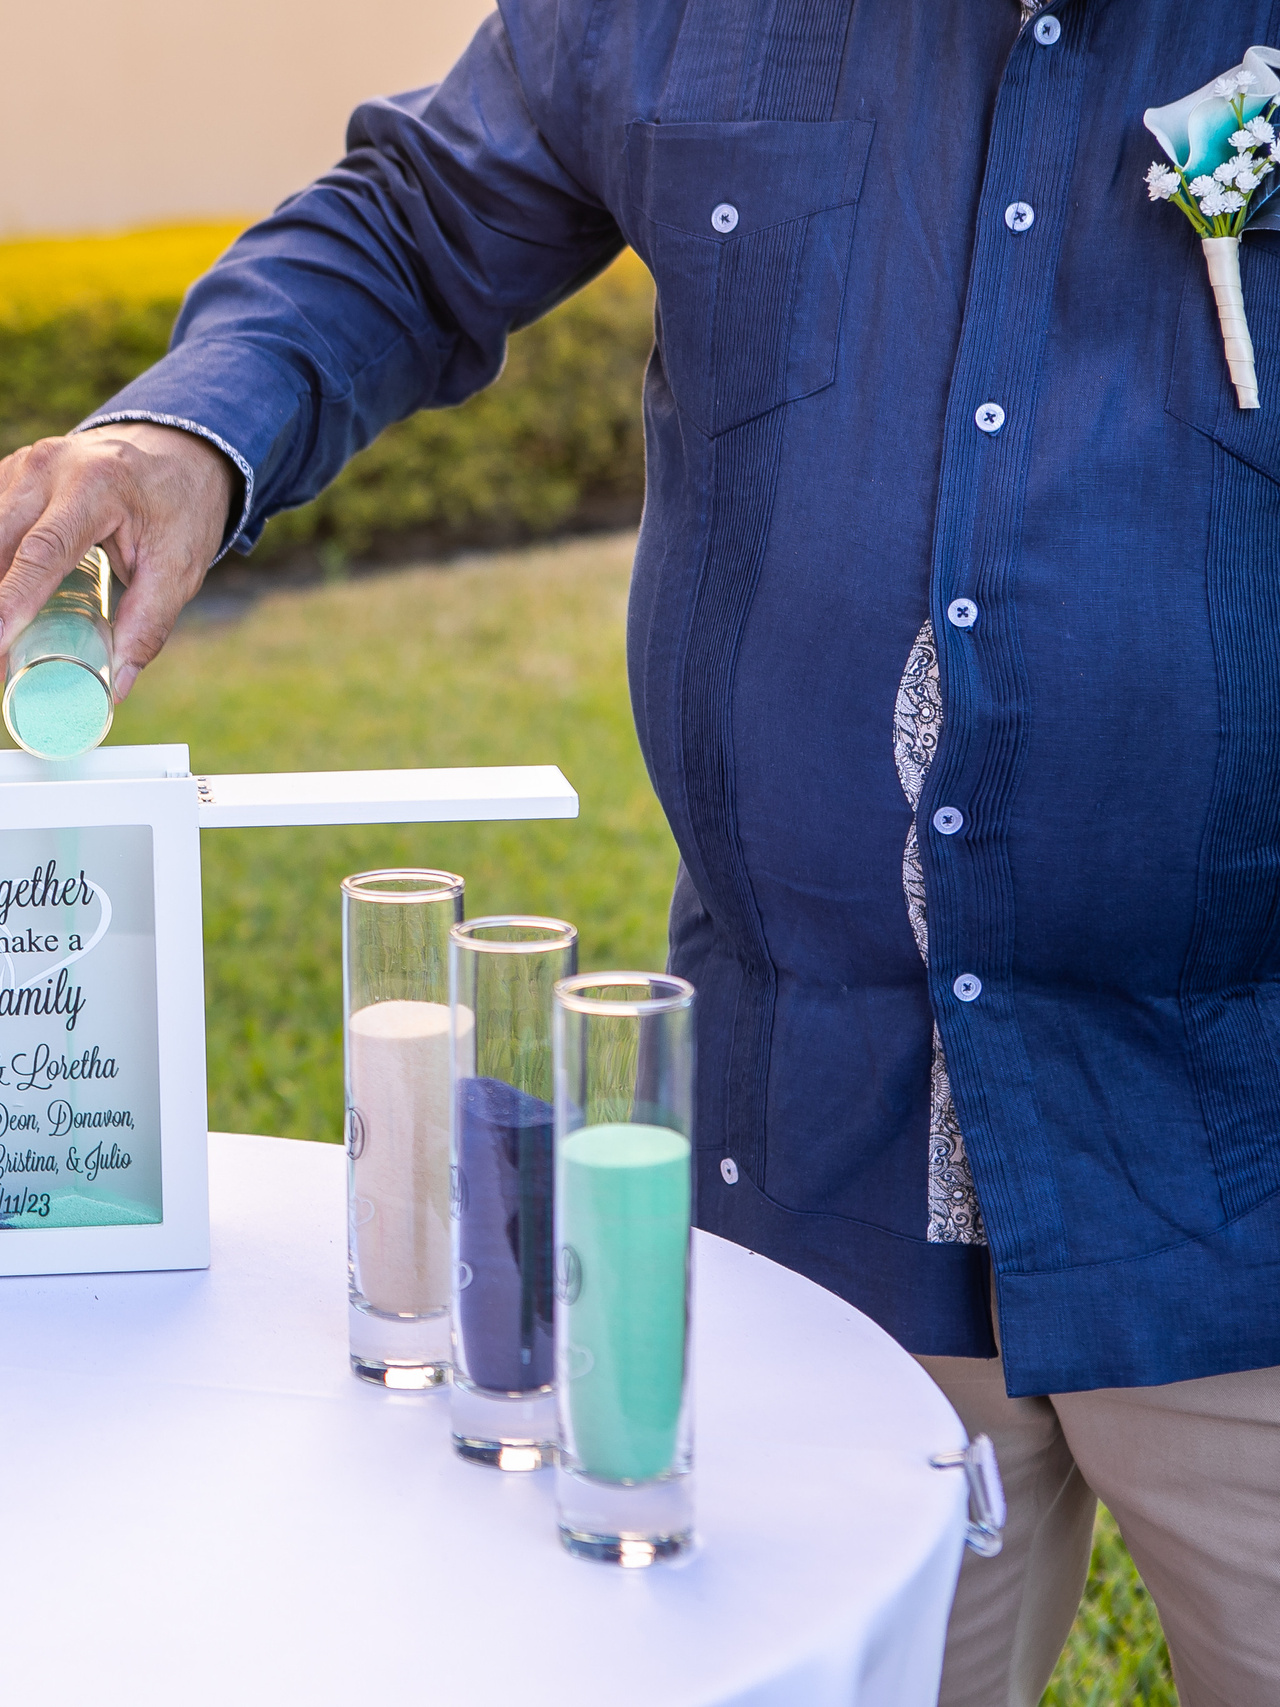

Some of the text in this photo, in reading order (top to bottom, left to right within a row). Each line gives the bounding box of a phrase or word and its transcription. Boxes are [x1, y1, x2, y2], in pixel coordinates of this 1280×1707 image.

[67, 933, 84, 951] a
[10, 1043, 120, 1091] Loretha
[47, 1099, 136, 1137] Donavon,
[65, 1146, 84, 1174] &
[83, 1140, 133, 1182] Julio
